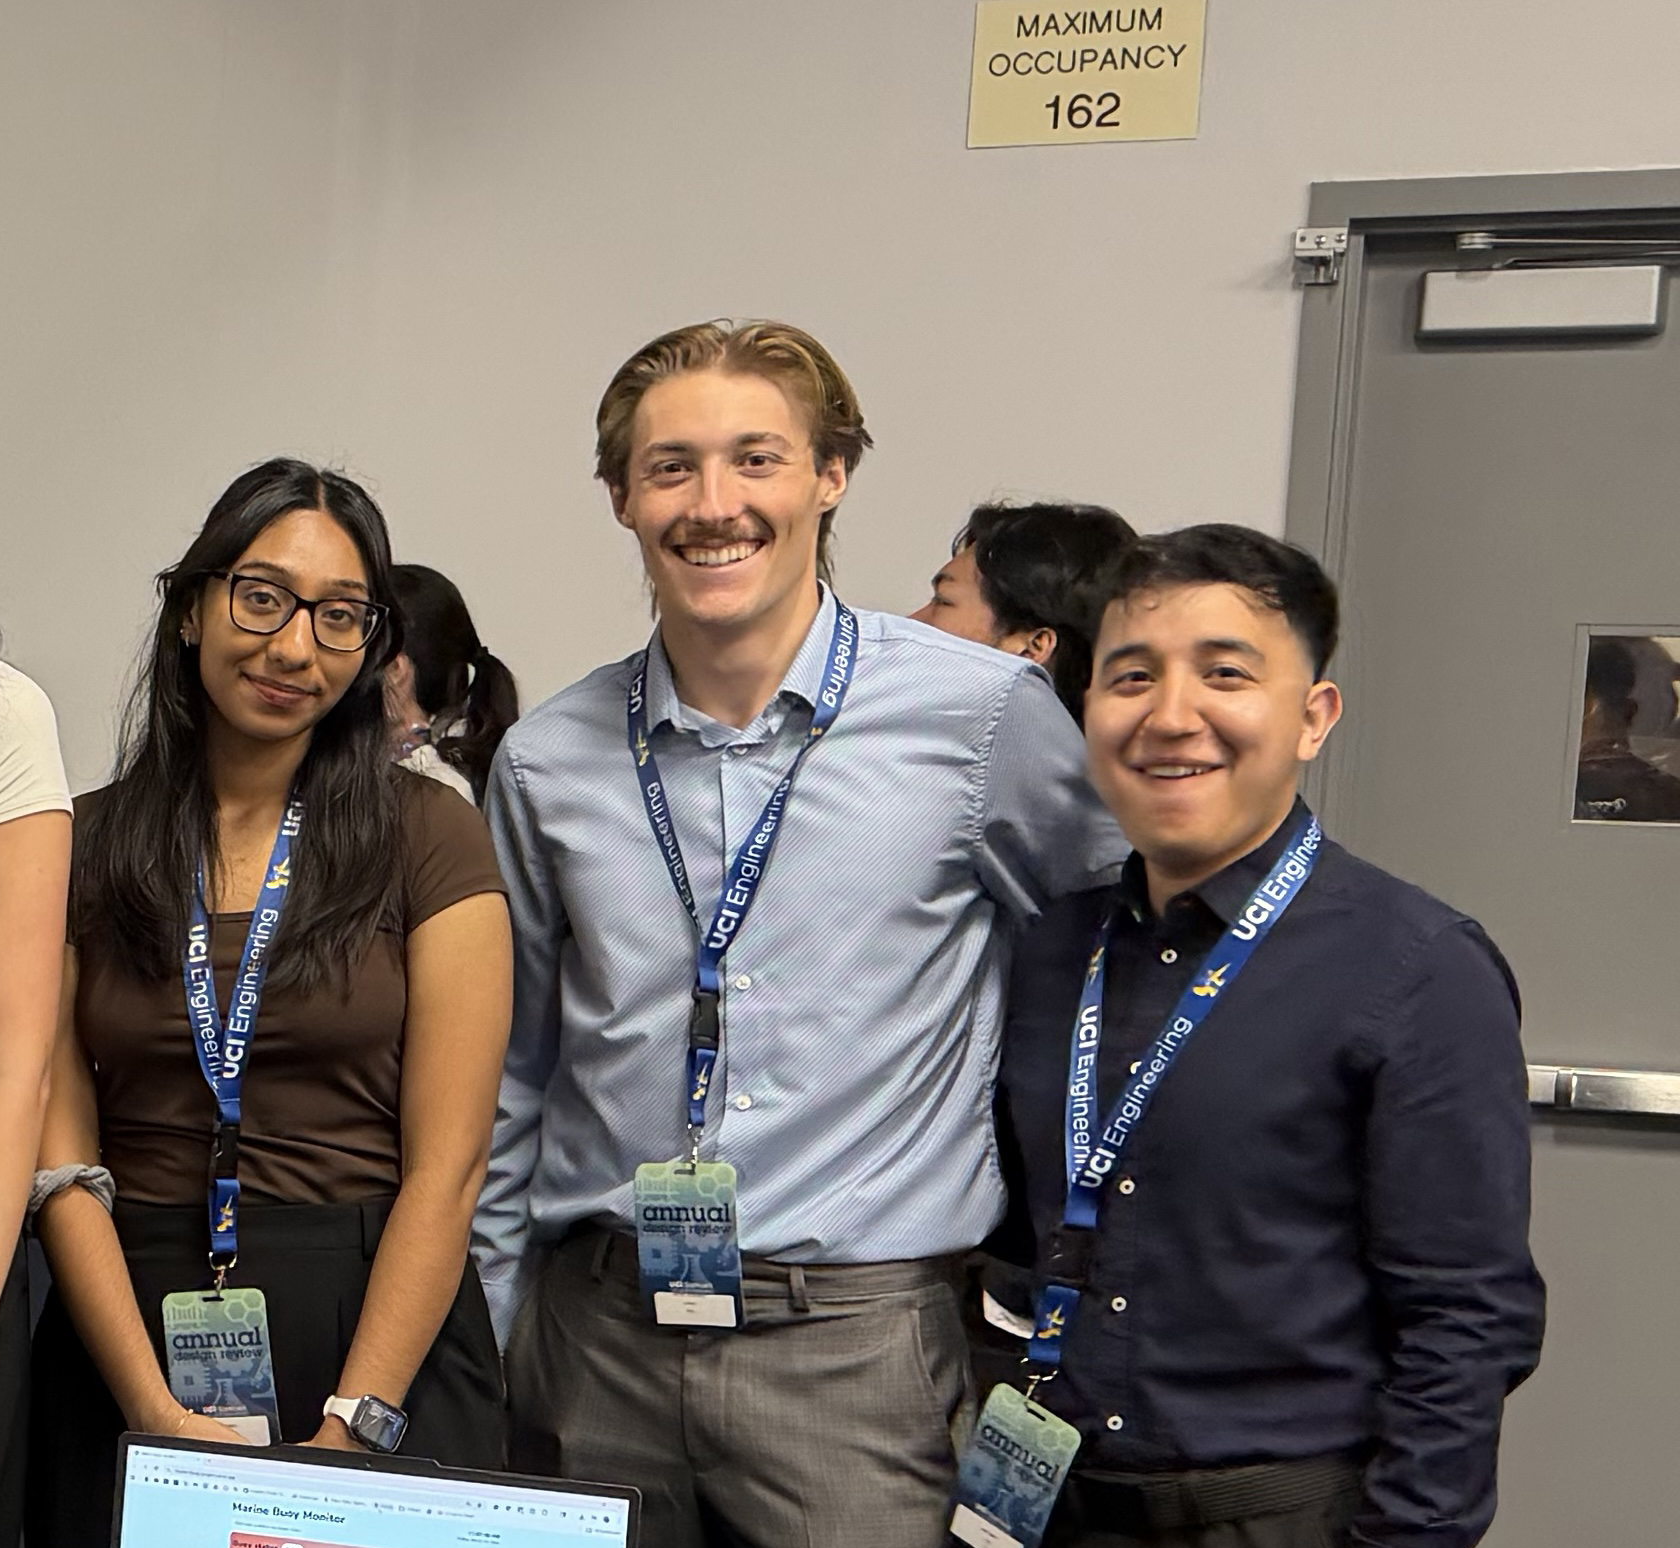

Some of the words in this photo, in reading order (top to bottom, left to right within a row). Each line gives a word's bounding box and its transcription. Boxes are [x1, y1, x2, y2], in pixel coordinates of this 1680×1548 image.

[1016, 7, 1162, 38] MAXIMUM
[988, 44, 1188, 77] OCCUPANCY
[1045, 92, 1121, 129] 162
[709, 908, 740, 950] UCI
[1232, 896, 1276, 942] UCI
[188, 925, 207, 964] UCI
[1080, 1004, 1098, 1050] UCI
[222, 1037, 246, 1080] UCI
[1079, 1145, 1117, 1188] UCI
[1103, 1015, 1194, 1147] Engineering
[643, 1203, 731, 1223] annual
[172, 1326, 262, 1350] annual
[232, 1501, 269, 1516] Marine
[303, 1510, 346, 1524] Monitor
